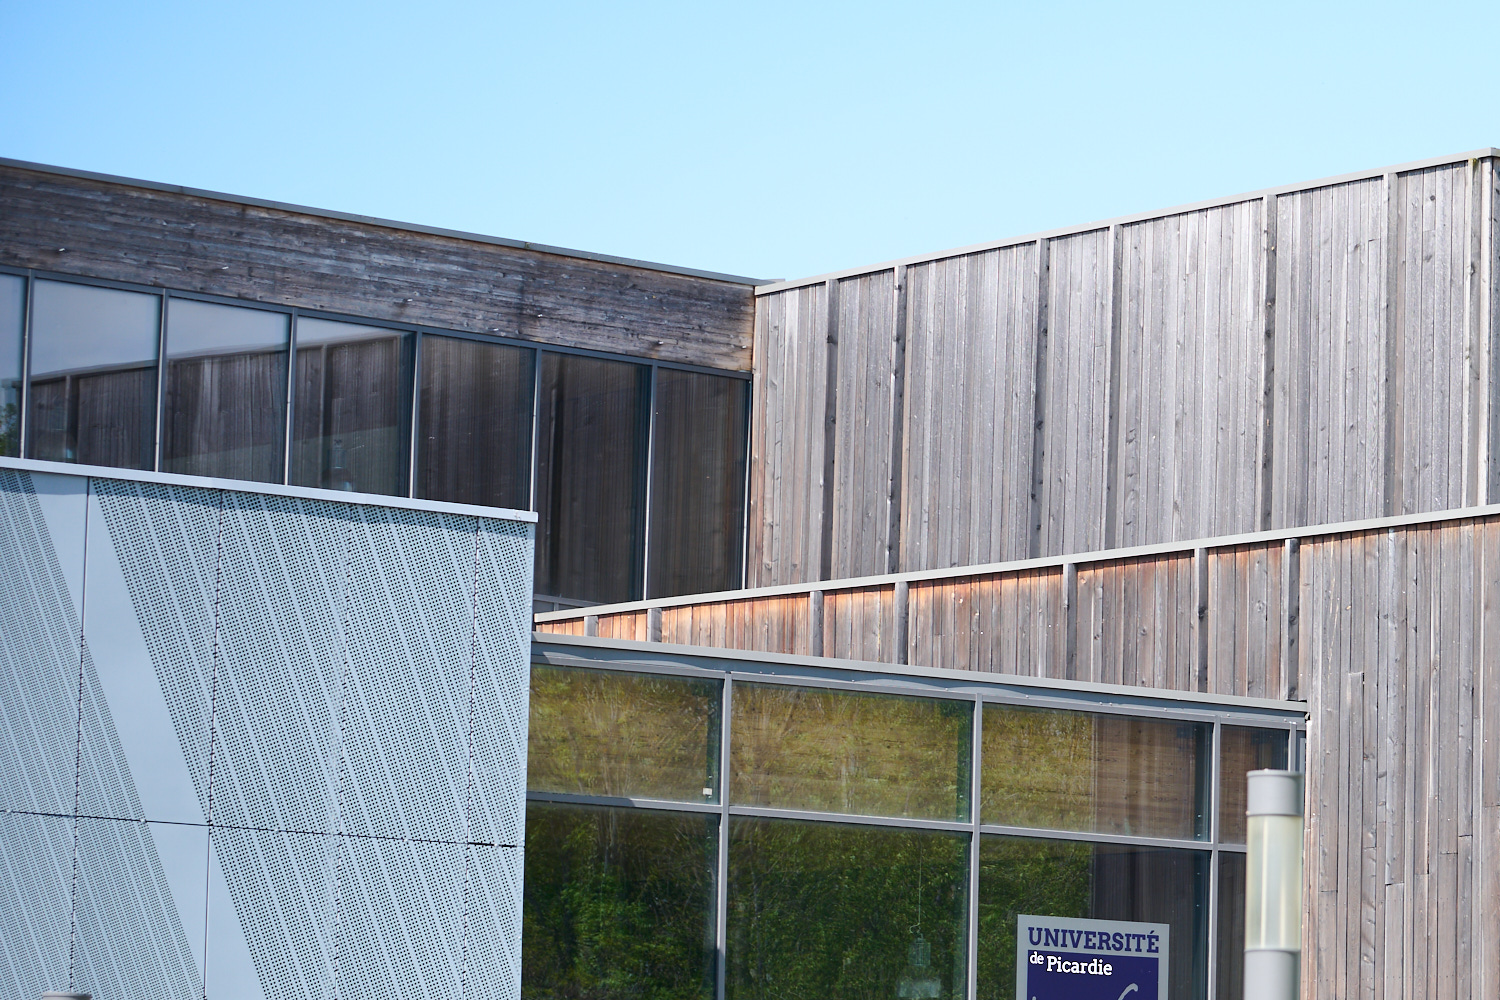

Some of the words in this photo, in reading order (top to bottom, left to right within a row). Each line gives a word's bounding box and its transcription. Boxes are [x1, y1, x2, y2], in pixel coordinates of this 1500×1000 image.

[1028, 927, 1160, 953] UNIVERSITÉ
[1029, 951, 1045, 965] de
[1046, 955, 1113, 976] Picardie
